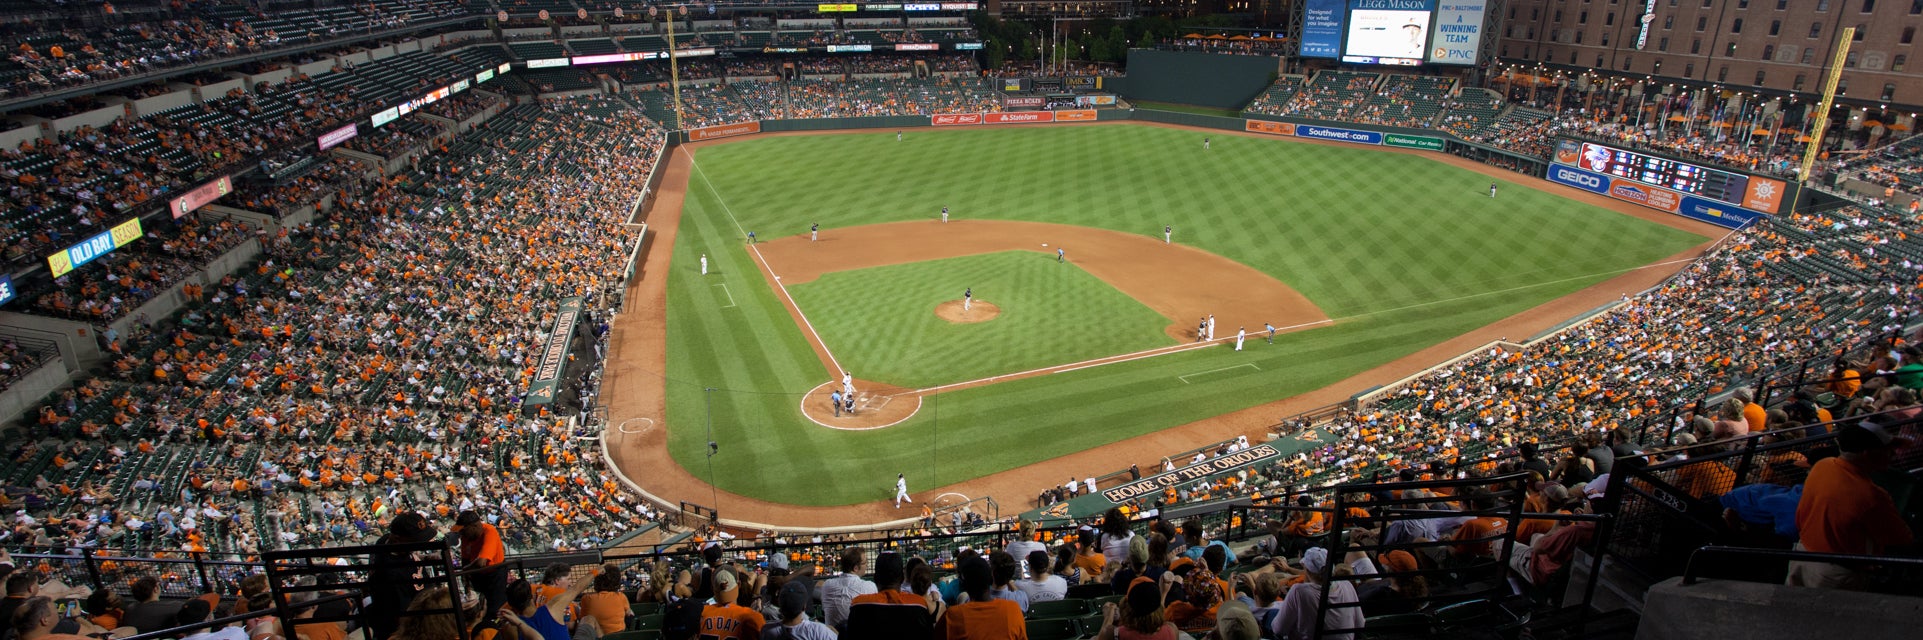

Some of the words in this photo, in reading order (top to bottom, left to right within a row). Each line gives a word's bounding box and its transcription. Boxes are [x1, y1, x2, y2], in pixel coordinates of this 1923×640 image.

[1359, 0, 1386, 9] LEGG
[1388, 0, 1425, 9] MASON
[1456, 15, 1463, 23] A
[1440, 24, 1478, 33] WINNING
[1445, 34, 1469, 43] TEAM
[1448, 49, 1474, 59] PNC
[1557, 168, 1600, 188] GEICO
[1614, 187, 1647, 200] HORIZON
[1647, 199, 1671, 209] COOLING
[114, 221, 141, 244] SEASON
[71, 242, 93, 265] OLD
[91, 233, 111, 256] BAY
[552, 335, 567, 344] TO
[544, 344, 564, 365] ORIOLE
[538, 364, 558, 380] PARK
[1105, 480, 1157, 502] HOME
[1157, 473, 1181, 486] OF
[1180, 463, 1217, 479] THE
[1213, 446, 1276, 469] ORIOLES
[705, 615, 740, 632] O'DAY
